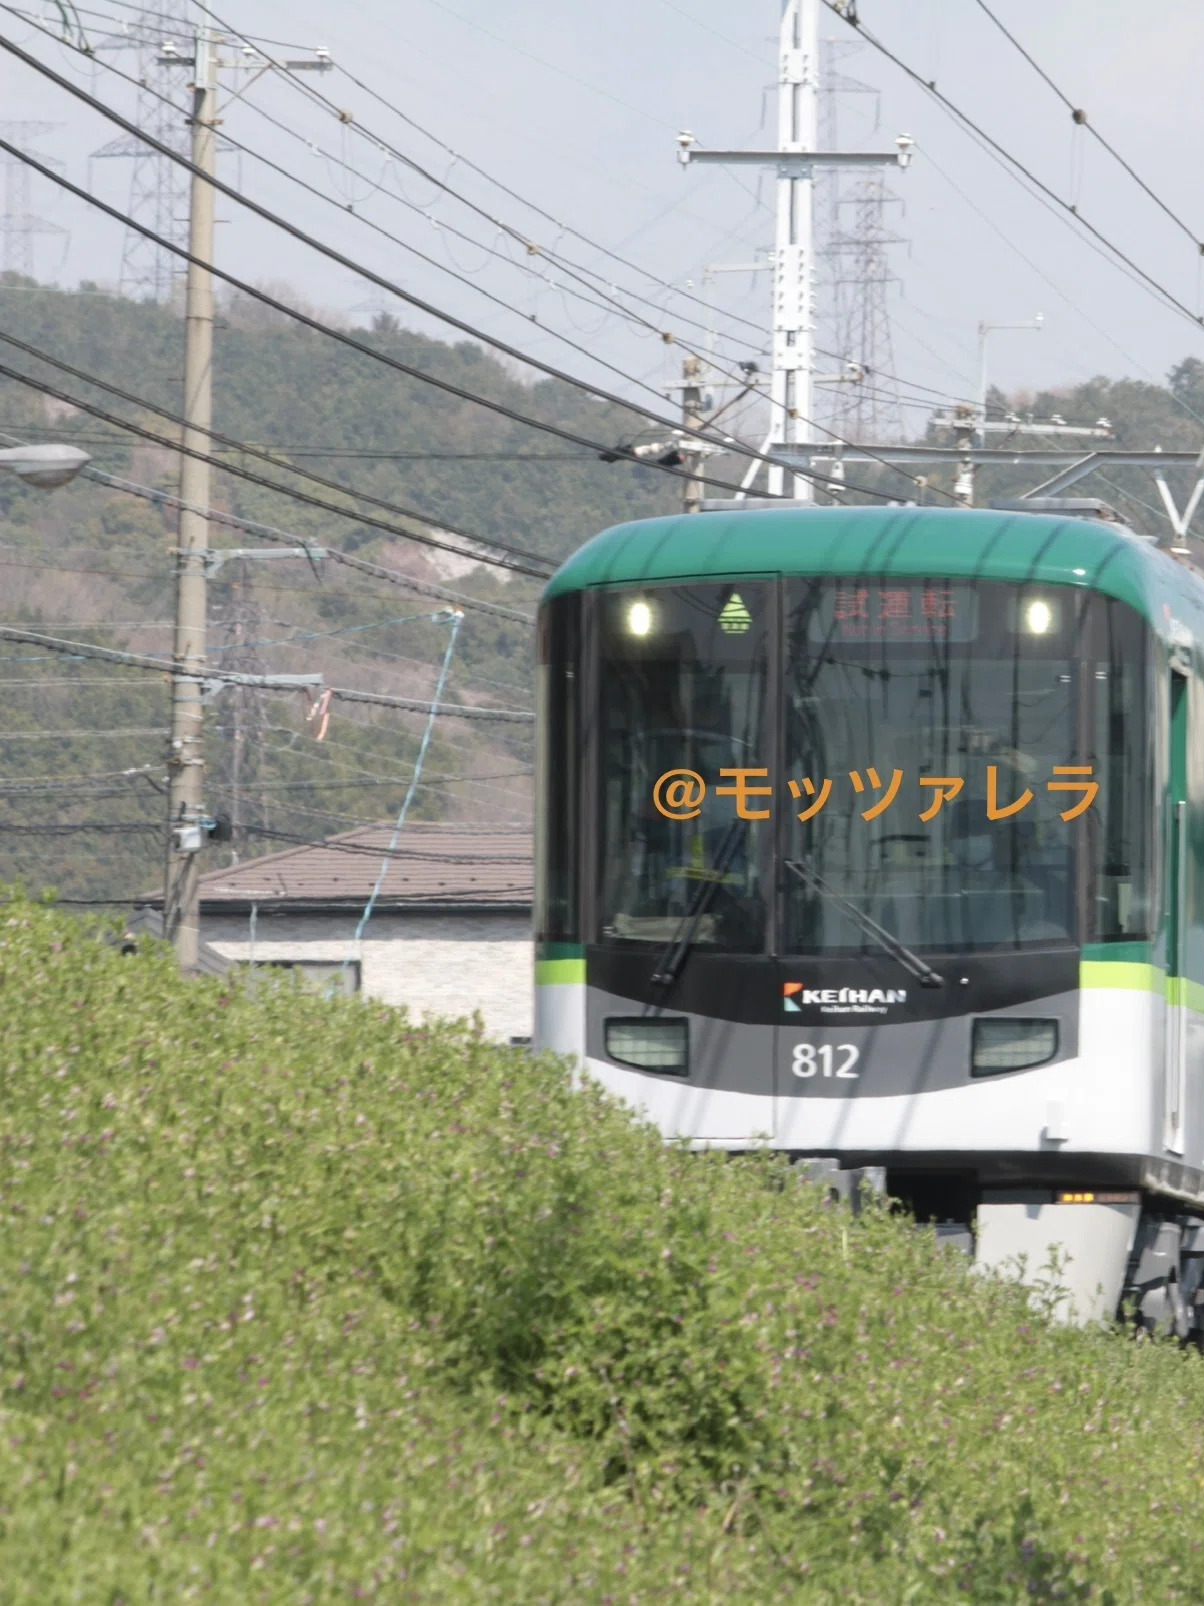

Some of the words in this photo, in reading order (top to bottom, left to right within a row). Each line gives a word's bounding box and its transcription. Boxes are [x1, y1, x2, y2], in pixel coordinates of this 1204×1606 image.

[834, 590, 957, 619] 試運転
[802, 988, 907, 1004] KEIHAN
[792, 1043, 859, 1078] 812
